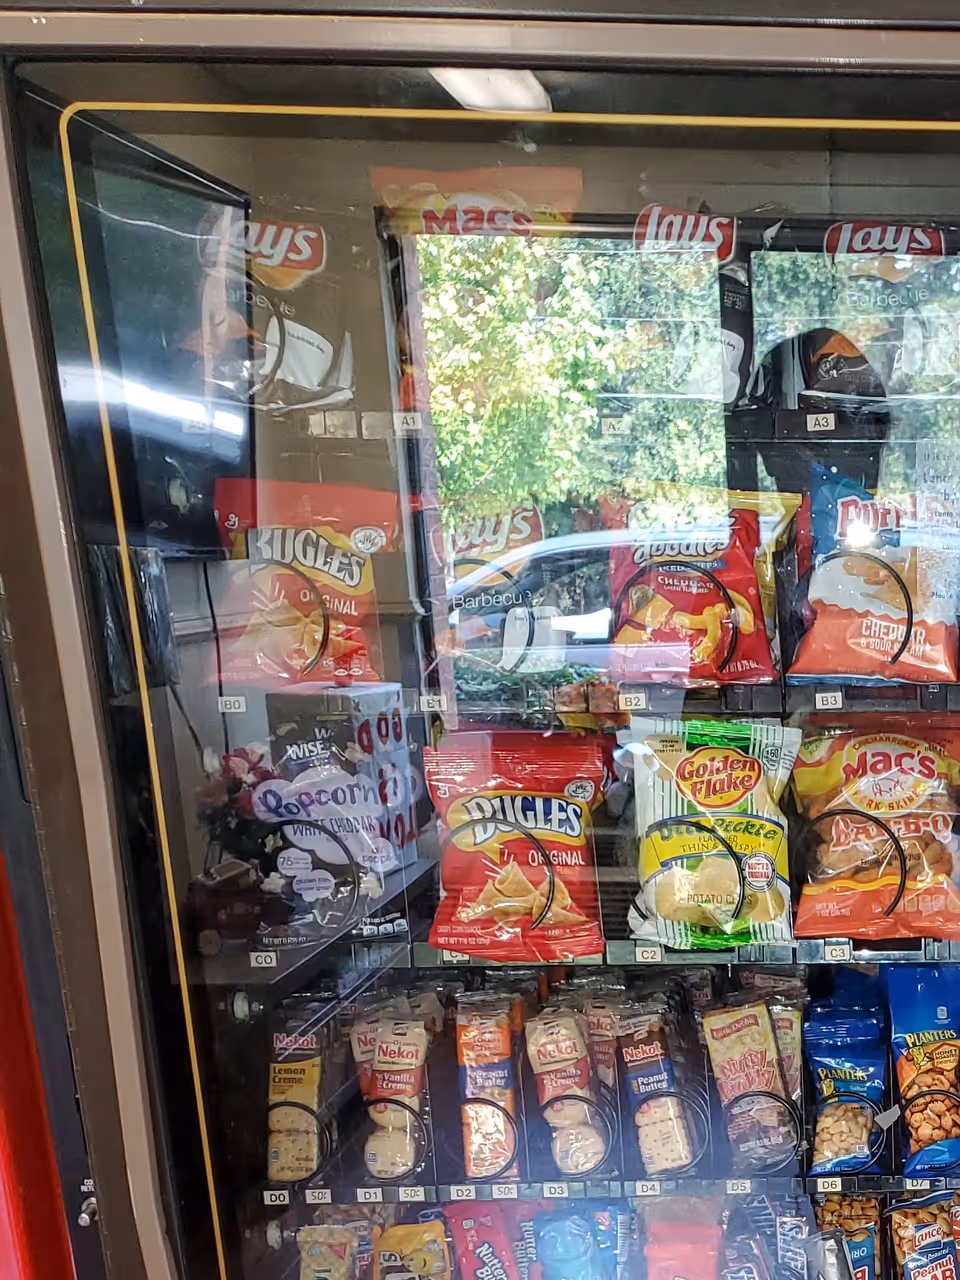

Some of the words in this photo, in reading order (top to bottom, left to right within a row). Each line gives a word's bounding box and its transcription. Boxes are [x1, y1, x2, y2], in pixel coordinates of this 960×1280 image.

[813, 416, 831, 429] A3
[427, 698, 442, 709] B1
[624, 697, 641, 707] B2
[821, 696, 838, 706] B3
[286, 740, 329, 761] WISE
[679, 754, 757, 781] Golden
[842, 750, 936, 783] Mac's
[689, 774, 754, 801] Flake
[259, 783, 380, 818] Popcorn
[330, 815, 376, 834] CHEDDAR
[464, 795, 583, 846] BUGLES
[711, 818, 779, 841] Pickle
[680, 842, 710, 854] THIN
[529, 850, 585, 866] ORGINAL
[687, 893, 723, 906] POTATO
[641, 950, 658, 960] C2
[830, 948, 846, 959] C3
[274, 1033, 316, 1049] Nekot
[905, 1029, 958, 1047] PLANTERS
[377, 1044, 420, 1060] Nekot
[537, 1042, 579, 1060] Nekot
[623, 1041, 662, 1062] Nekot
[934, 1048, 957, 1056] HONEY
[272, 1066, 306, 1077] Lemon
[384, 1073, 415, 1083] Vanilla
[818, 1066, 868, 1082] PLANTERS
[272, 1075, 304, 1085] Creme
[638, 1072, 668, 1085] Peanut
[383, 1081, 412, 1091] Creme
[639, 1080, 668, 1093] Butter
[641, 1184, 656, 1193] D4
[731, 1182, 746, 1192] D5
[822, 1180, 838, 1190] D6
[911, 1179, 925, 1187] D7
[364, 1191, 378, 1201] D1
[456, 1188, 472, 1198] D2
[549, 1186, 565, 1195] D3
[269, 1193, 286, 1203] D0
[520, 1220, 537, 1262] Nutter
[913, 1226, 942, 1249] Lance
[513, 1241, 530, 1280] Butter
[927, 1248, 950, 1260] Roasted
